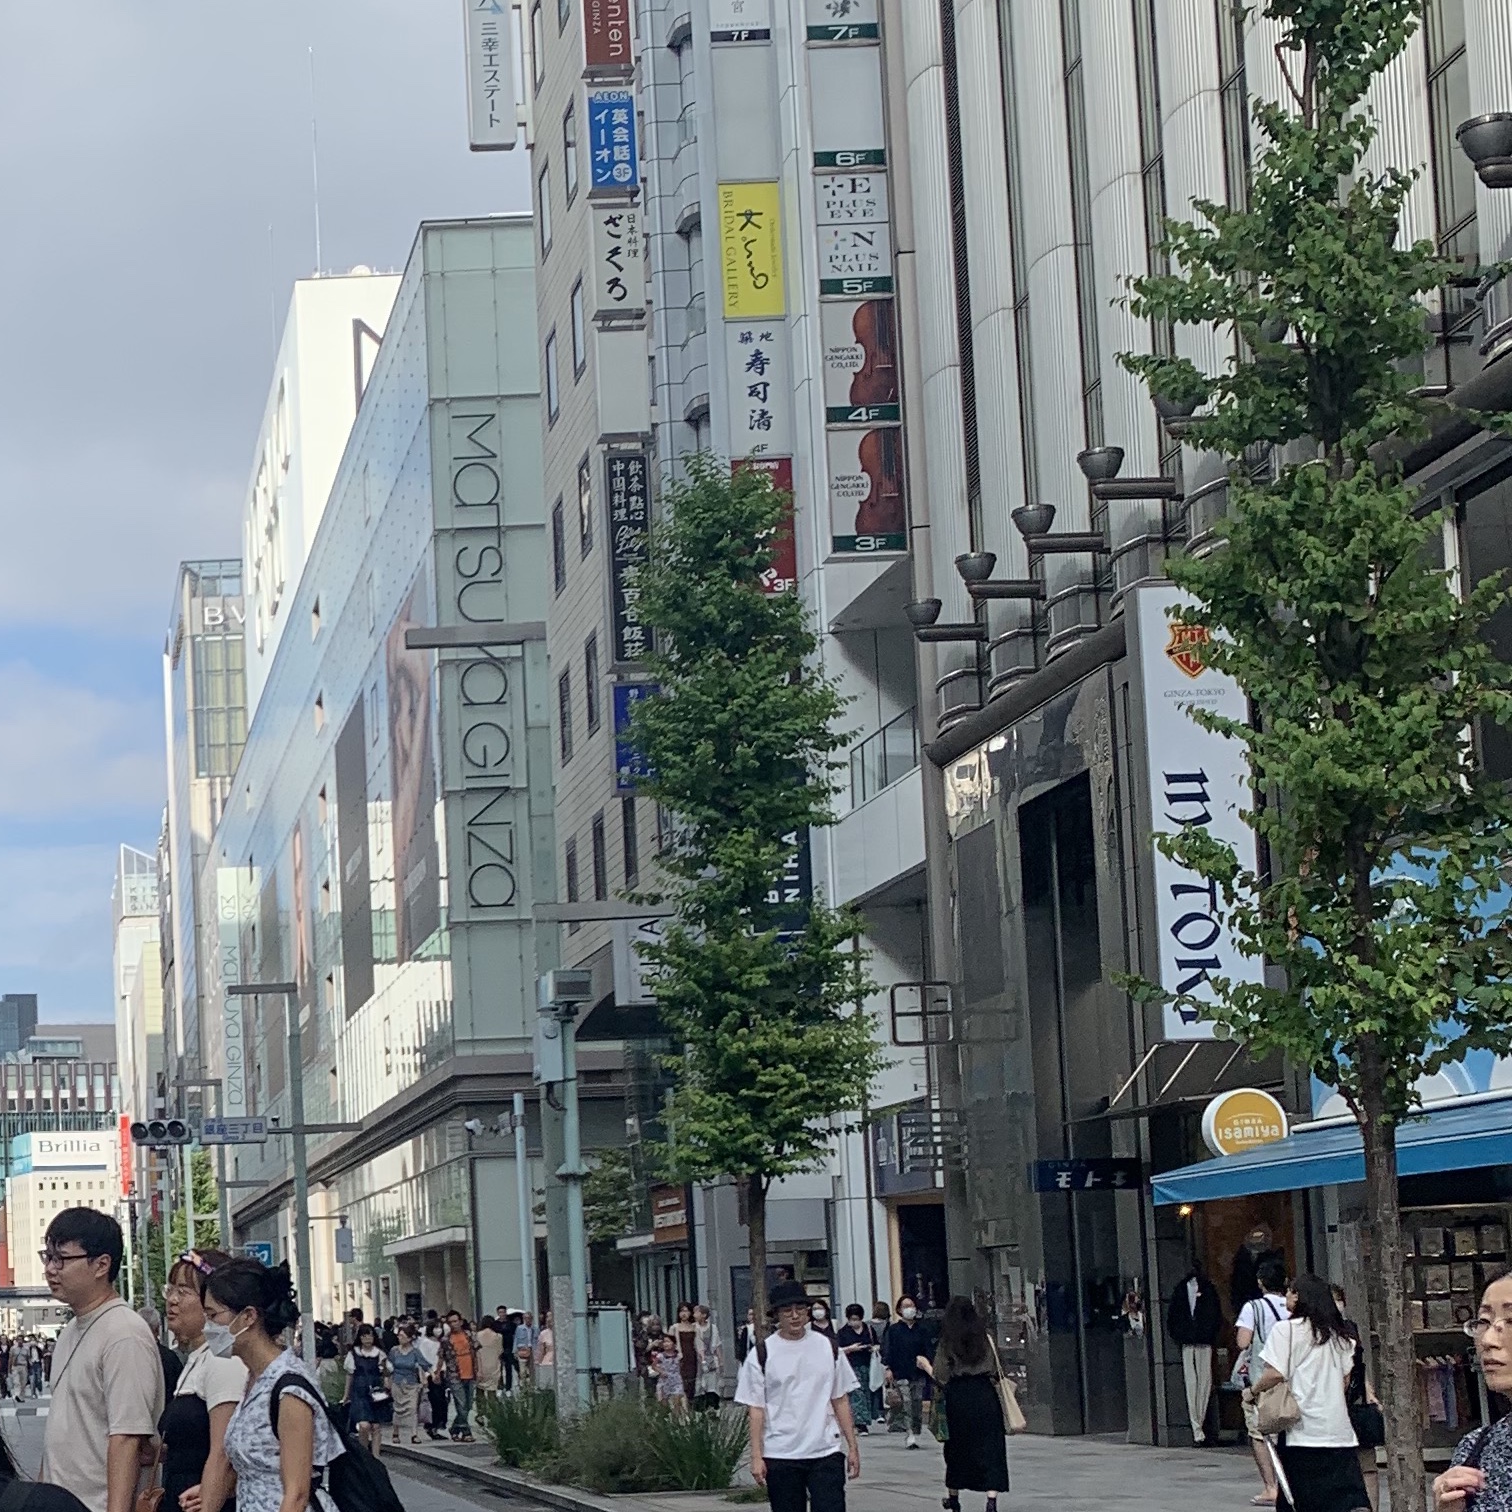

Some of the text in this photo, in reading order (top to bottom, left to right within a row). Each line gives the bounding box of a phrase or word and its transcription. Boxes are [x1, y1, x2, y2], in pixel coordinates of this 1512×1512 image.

[591, 1, 601, 34] GINZA
[731, 31, 749, 41] 7F
[827, 26, 859, 41] 7F
[481, 22, 500, 127] 三幸エステート
[594, 91, 629, 103] AEON
[611, 108, 630, 160] 英会話
[594, 109, 611, 182] イーオン
[835, 152, 866, 166] 6F
[826, 199, 877, 209] PLUS
[829, 208, 874, 219] EYE
[723, 190, 739, 309] BRIDAL GALLERY
[603, 213, 628, 302] ざくろ
[828, 252, 879, 263] PLUS
[830, 263, 879, 274] NAIL
[842, 279, 874, 294] 5F
[847, 407, 879, 422] 4F
[854, 535, 887, 551] 3F
[773, 578, 794, 592] 3F
[38, 1140, 101, 1153] Brillia
